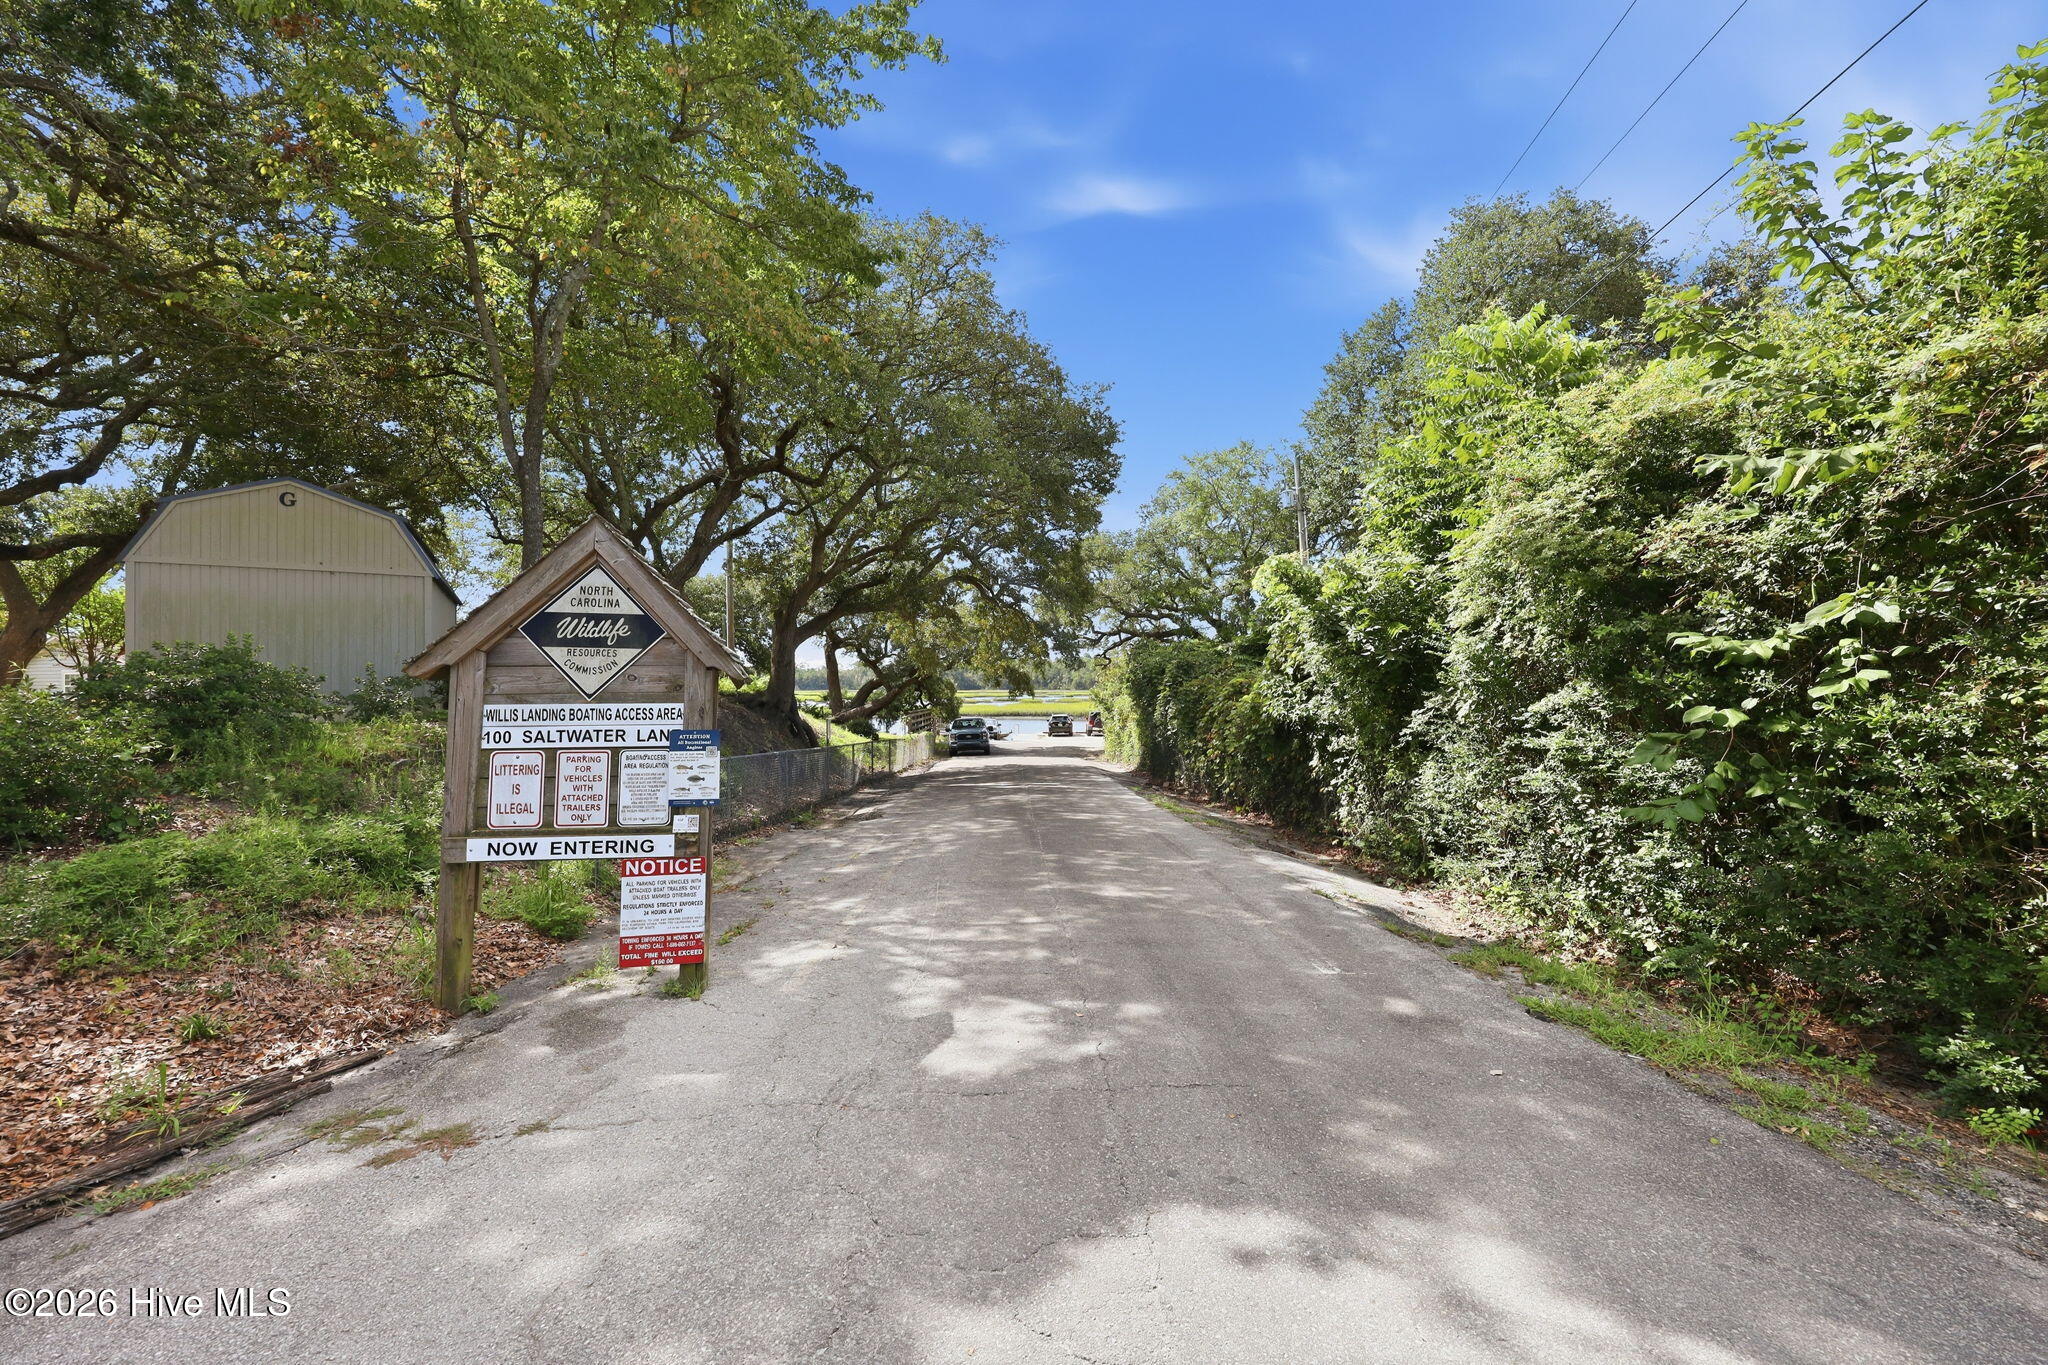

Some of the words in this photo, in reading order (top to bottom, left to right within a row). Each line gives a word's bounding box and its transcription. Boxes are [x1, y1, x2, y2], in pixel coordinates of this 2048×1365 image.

[279, 492, 296, 506] G
[580, 586, 613, 595] NORTH
[570, 598, 620, 608] CAROLINA
[556, 617, 631, 645] Wildlife
[567, 649, 617, 657] RESOURCES
[564, 659, 618, 675] COMMISSION
[486, 709, 518, 722] WILLIS
[522, 708, 565, 721] LANDING
[569, 708, 612, 721] BOATING
[615, 708, 654, 720] ACCESS
[656, 708, 683, 720] AREA
[484, 731, 511, 744] 100
[522, 729, 626, 743] SALTWATER
[637, 729, 670, 742] LAN
[494, 764, 540, 776] LITTERING
[512, 783, 521, 795] IS
[561, 794, 603, 802] ATTACHED
[496, 803, 534, 814] ILLEGAL
[487, 842, 538, 856] NOW
[550, 840, 654, 855] ENTERING
[625, 858, 702, 875] NOTICE
